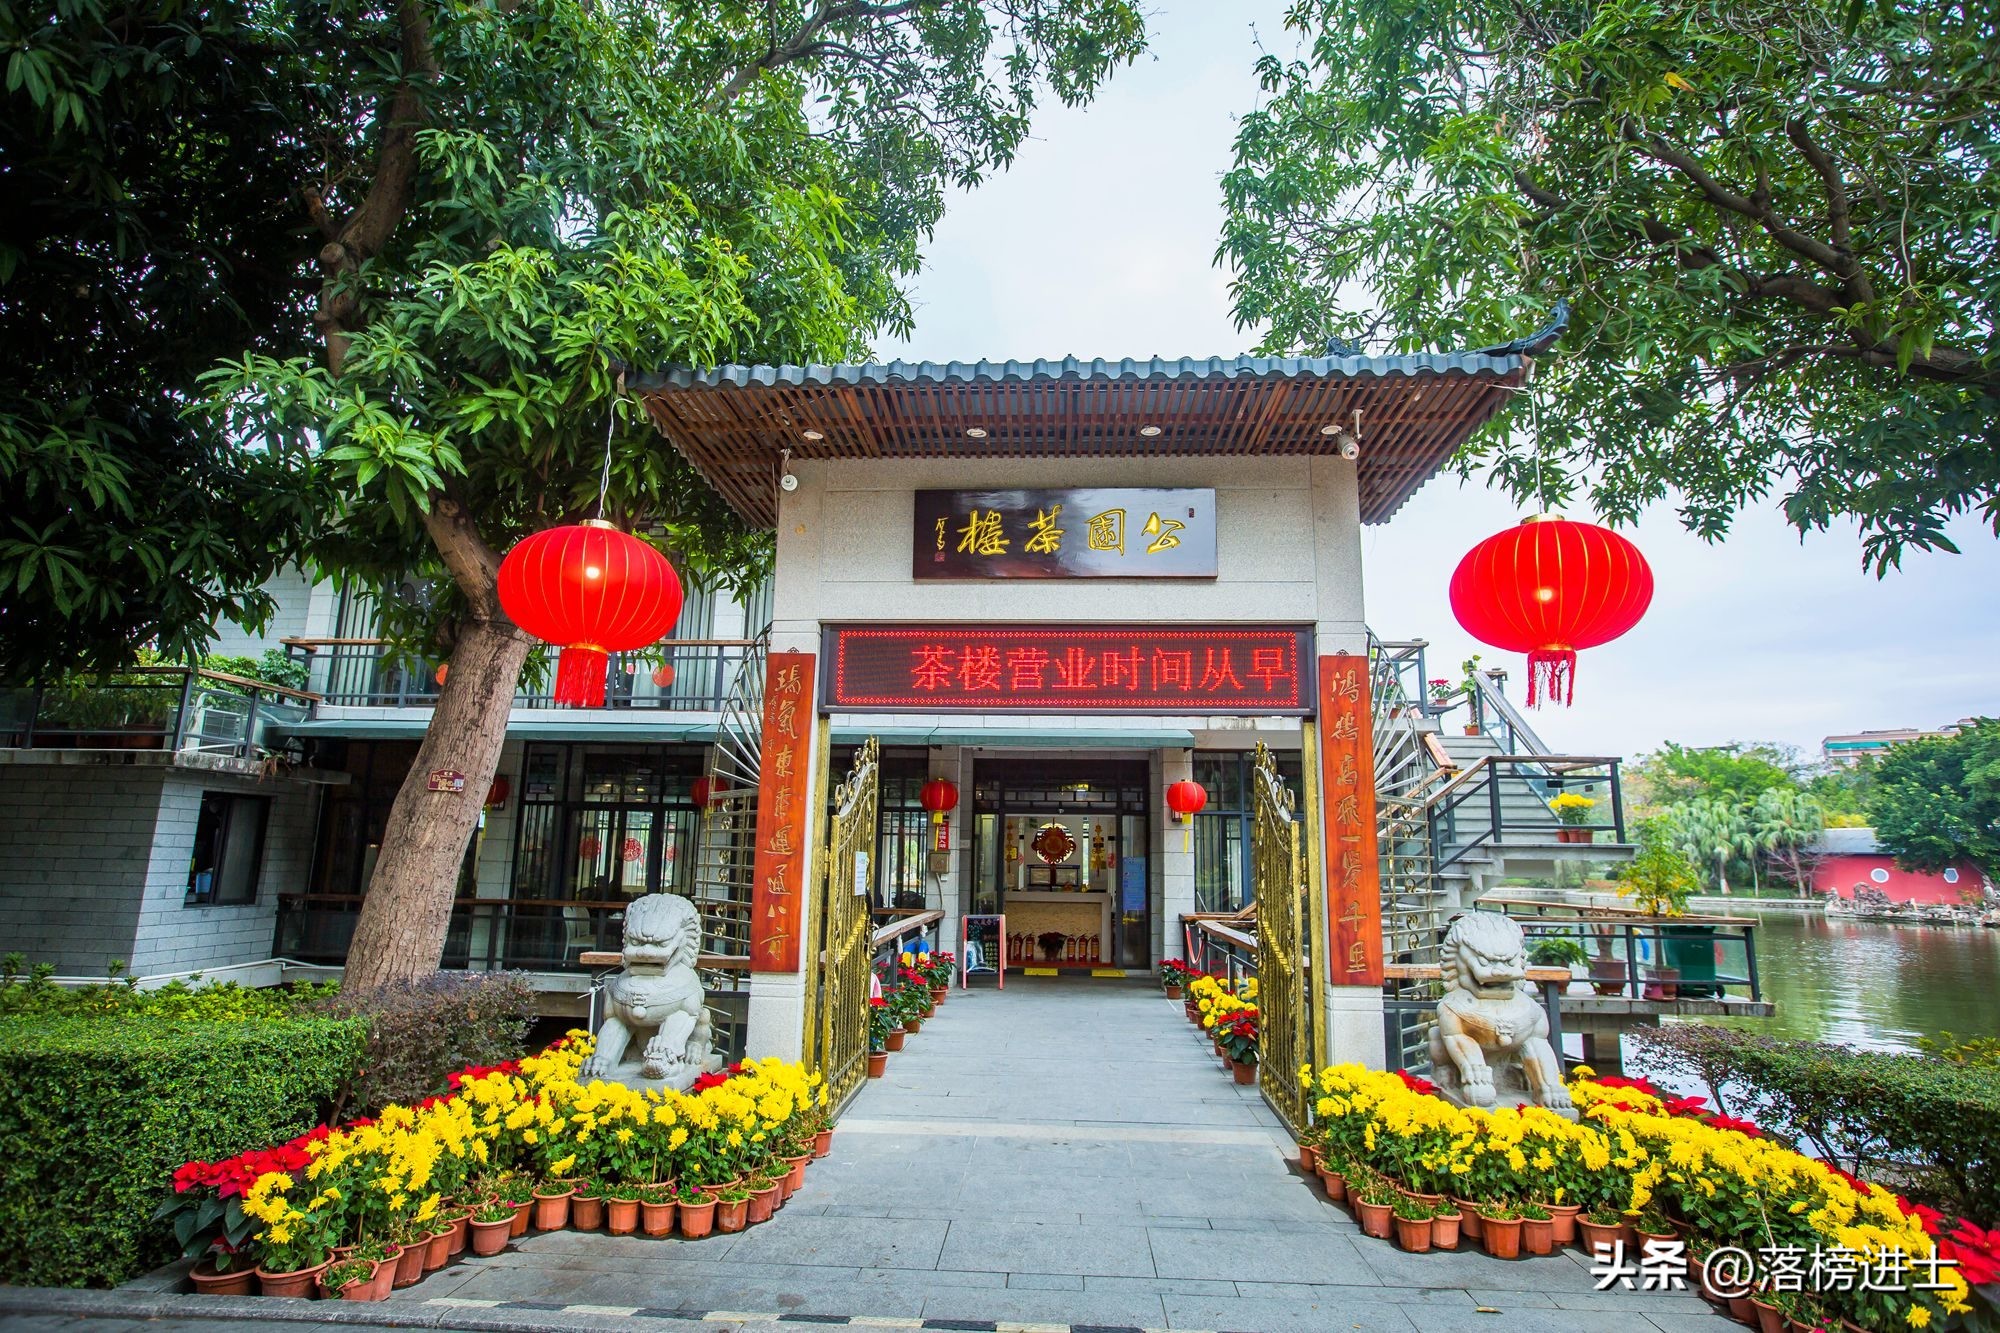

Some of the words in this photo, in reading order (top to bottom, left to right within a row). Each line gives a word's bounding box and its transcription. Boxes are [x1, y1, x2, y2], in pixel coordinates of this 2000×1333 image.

[910, 643, 1291, 692] 茶楼营业时间从早
